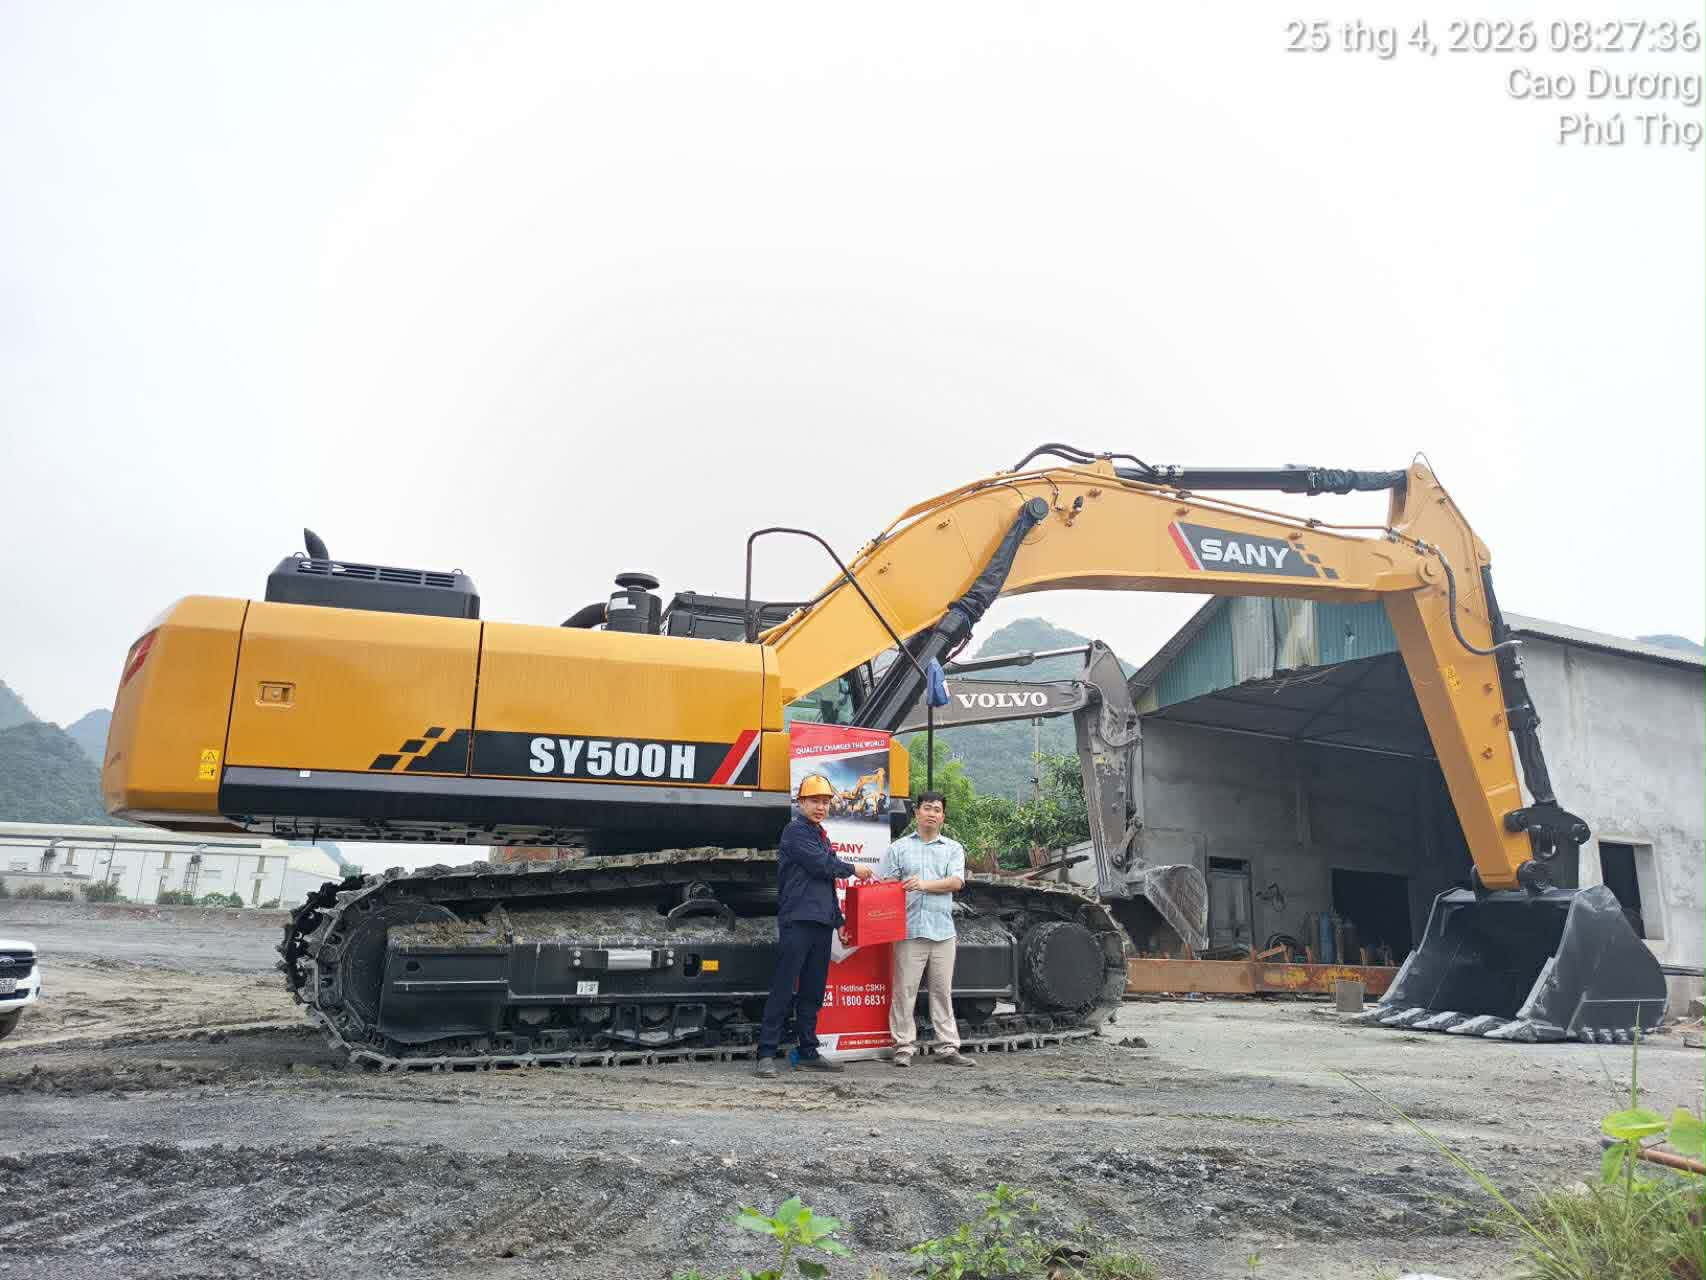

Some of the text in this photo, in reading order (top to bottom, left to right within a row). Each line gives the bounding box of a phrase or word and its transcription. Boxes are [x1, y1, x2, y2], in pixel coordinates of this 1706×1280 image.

[1200, 538, 1289, 569] SANY
[955, 691, 1048, 709] VOLVO
[796, 745, 823, 754] QUALITY
[824, 743, 851, 752] CHANGES
[529, 737, 696, 779] SY500H
[831, 842, 864, 854] SANY
[840, 984, 864, 992] Hotline
[841, 994, 886, 1006] 1800 6831
